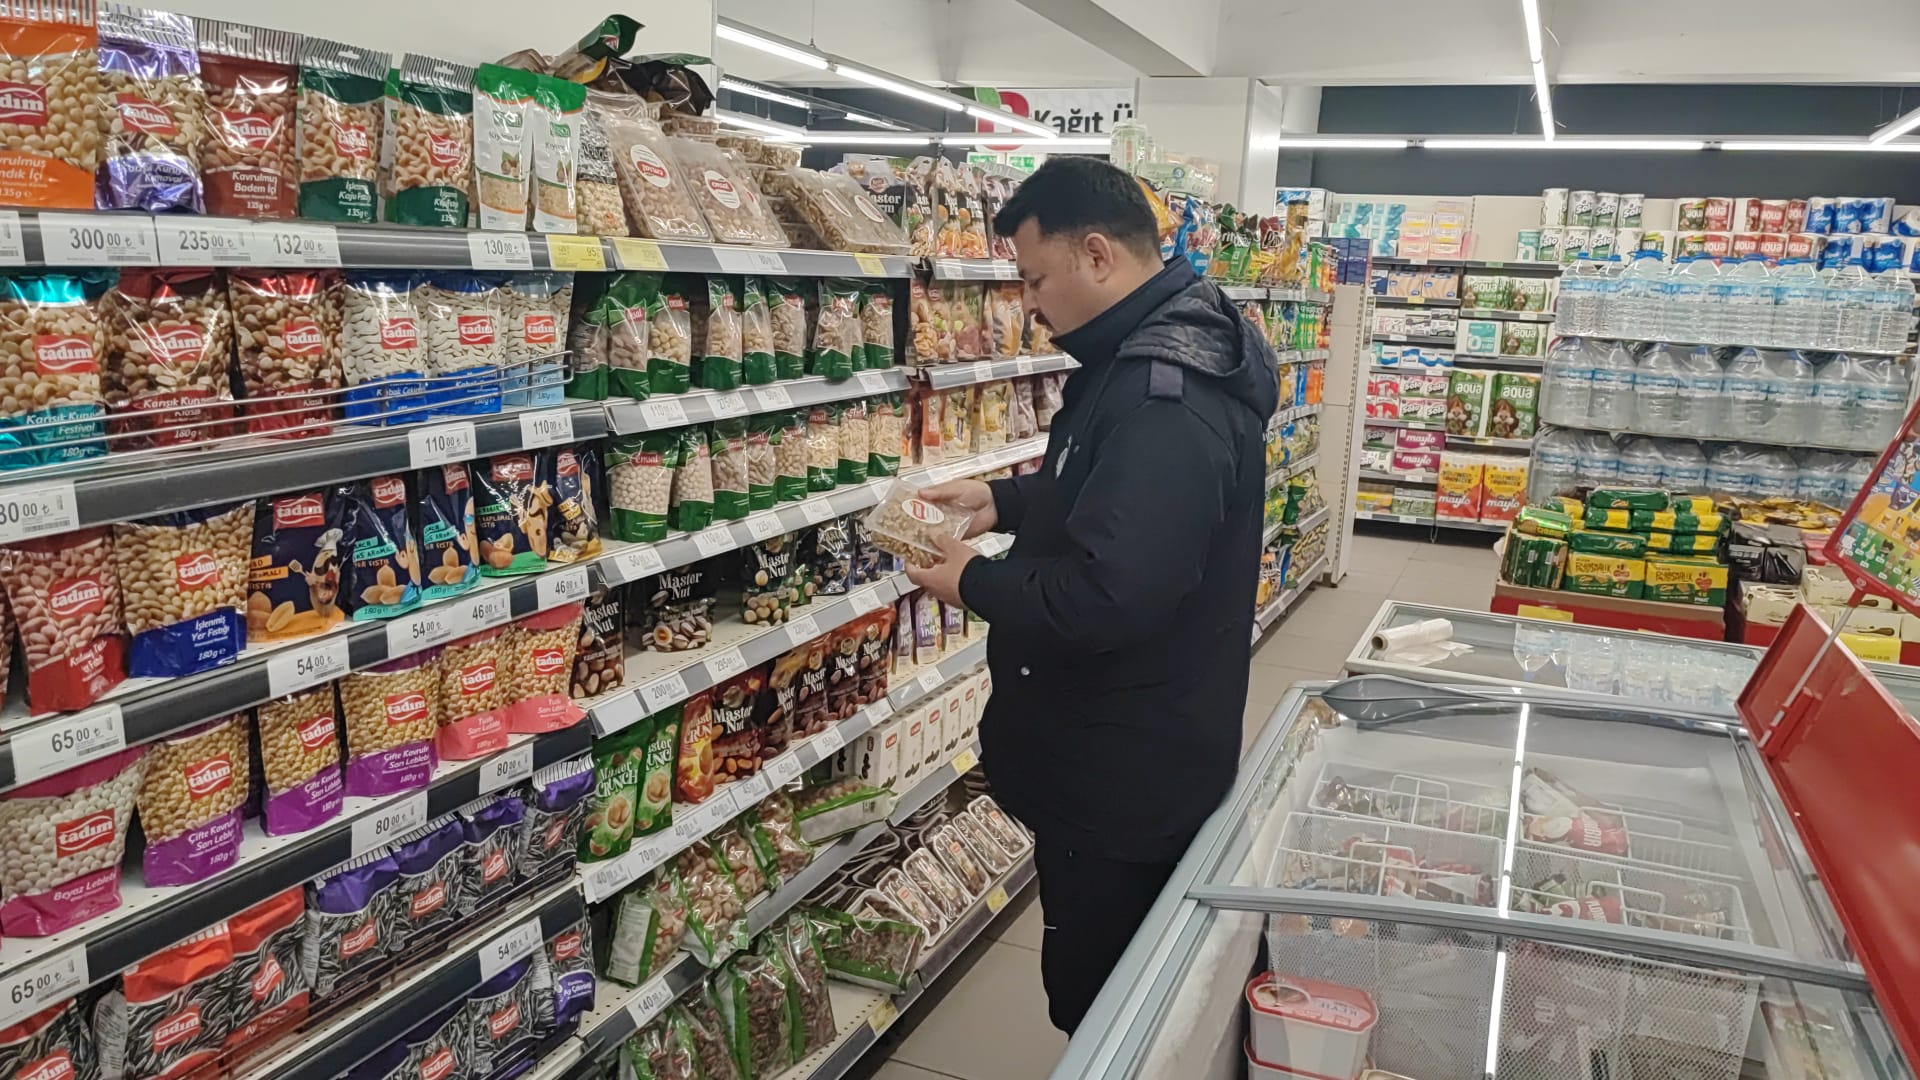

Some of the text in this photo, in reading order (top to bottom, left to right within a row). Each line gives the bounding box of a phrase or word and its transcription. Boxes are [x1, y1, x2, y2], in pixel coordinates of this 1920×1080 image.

[0, 95, 44, 112] dım
[1034, 108, 1103, 133] Kağıt
[0, 168, 25, 179] ndık
[70, 228, 121, 250] 300 00
[178, 230, 223, 250] 235 00
[273, 234, 315, 255] 132 00
[484, 240, 503, 255] 130
[382, 325, 417, 339] tadım
[38, 345, 93, 361] tadım
[1502, 385, 1532, 400] aqua
[533, 419, 550, 436] 110
[425, 436, 445, 453] 110
[1406, 434, 1437, 447] maylo
[22, 502, 37, 517] 00
[1438, 494, 1471, 508] maylo
[276, 502, 323, 521] tadım
[178, 560, 216, 579] tadım
[555, 581, 566, 595] 46
[658, 571, 704, 590] Master
[50, 586, 101, 609] tadım
[671, 585, 691, 601] Nut
[472, 605, 484, 620] 46
[191, 630, 206, 642] Yer
[412, 621, 435, 640] 54 00
[594, 619, 615, 636] Nut
[297, 654, 325, 676] 54 00
[535, 655, 564, 667] tadım
[462, 670, 496, 686] tadım
[386, 698, 426, 714] tadım
[713, 704, 753, 724] Master
[300, 721, 335, 742] tadım
[726, 719, 745, 735] Nut
[51, 726, 91, 753] 65 00
[188, 765, 232, 788] tadım
[497, 761, 509, 777] 80
[595, 769, 639, 798] CRUNCH
[58, 818, 113, 846] tadım
[375, 813, 400, 834] 80 00
[54, 885, 85, 902] Beyaz
[414, 890, 445, 909] tadım
[343, 926, 375, 952] tadım
[498, 946, 510, 961] 54
[11, 973, 51, 1005] 65 00
[154, 1014, 200, 1040] tadım
